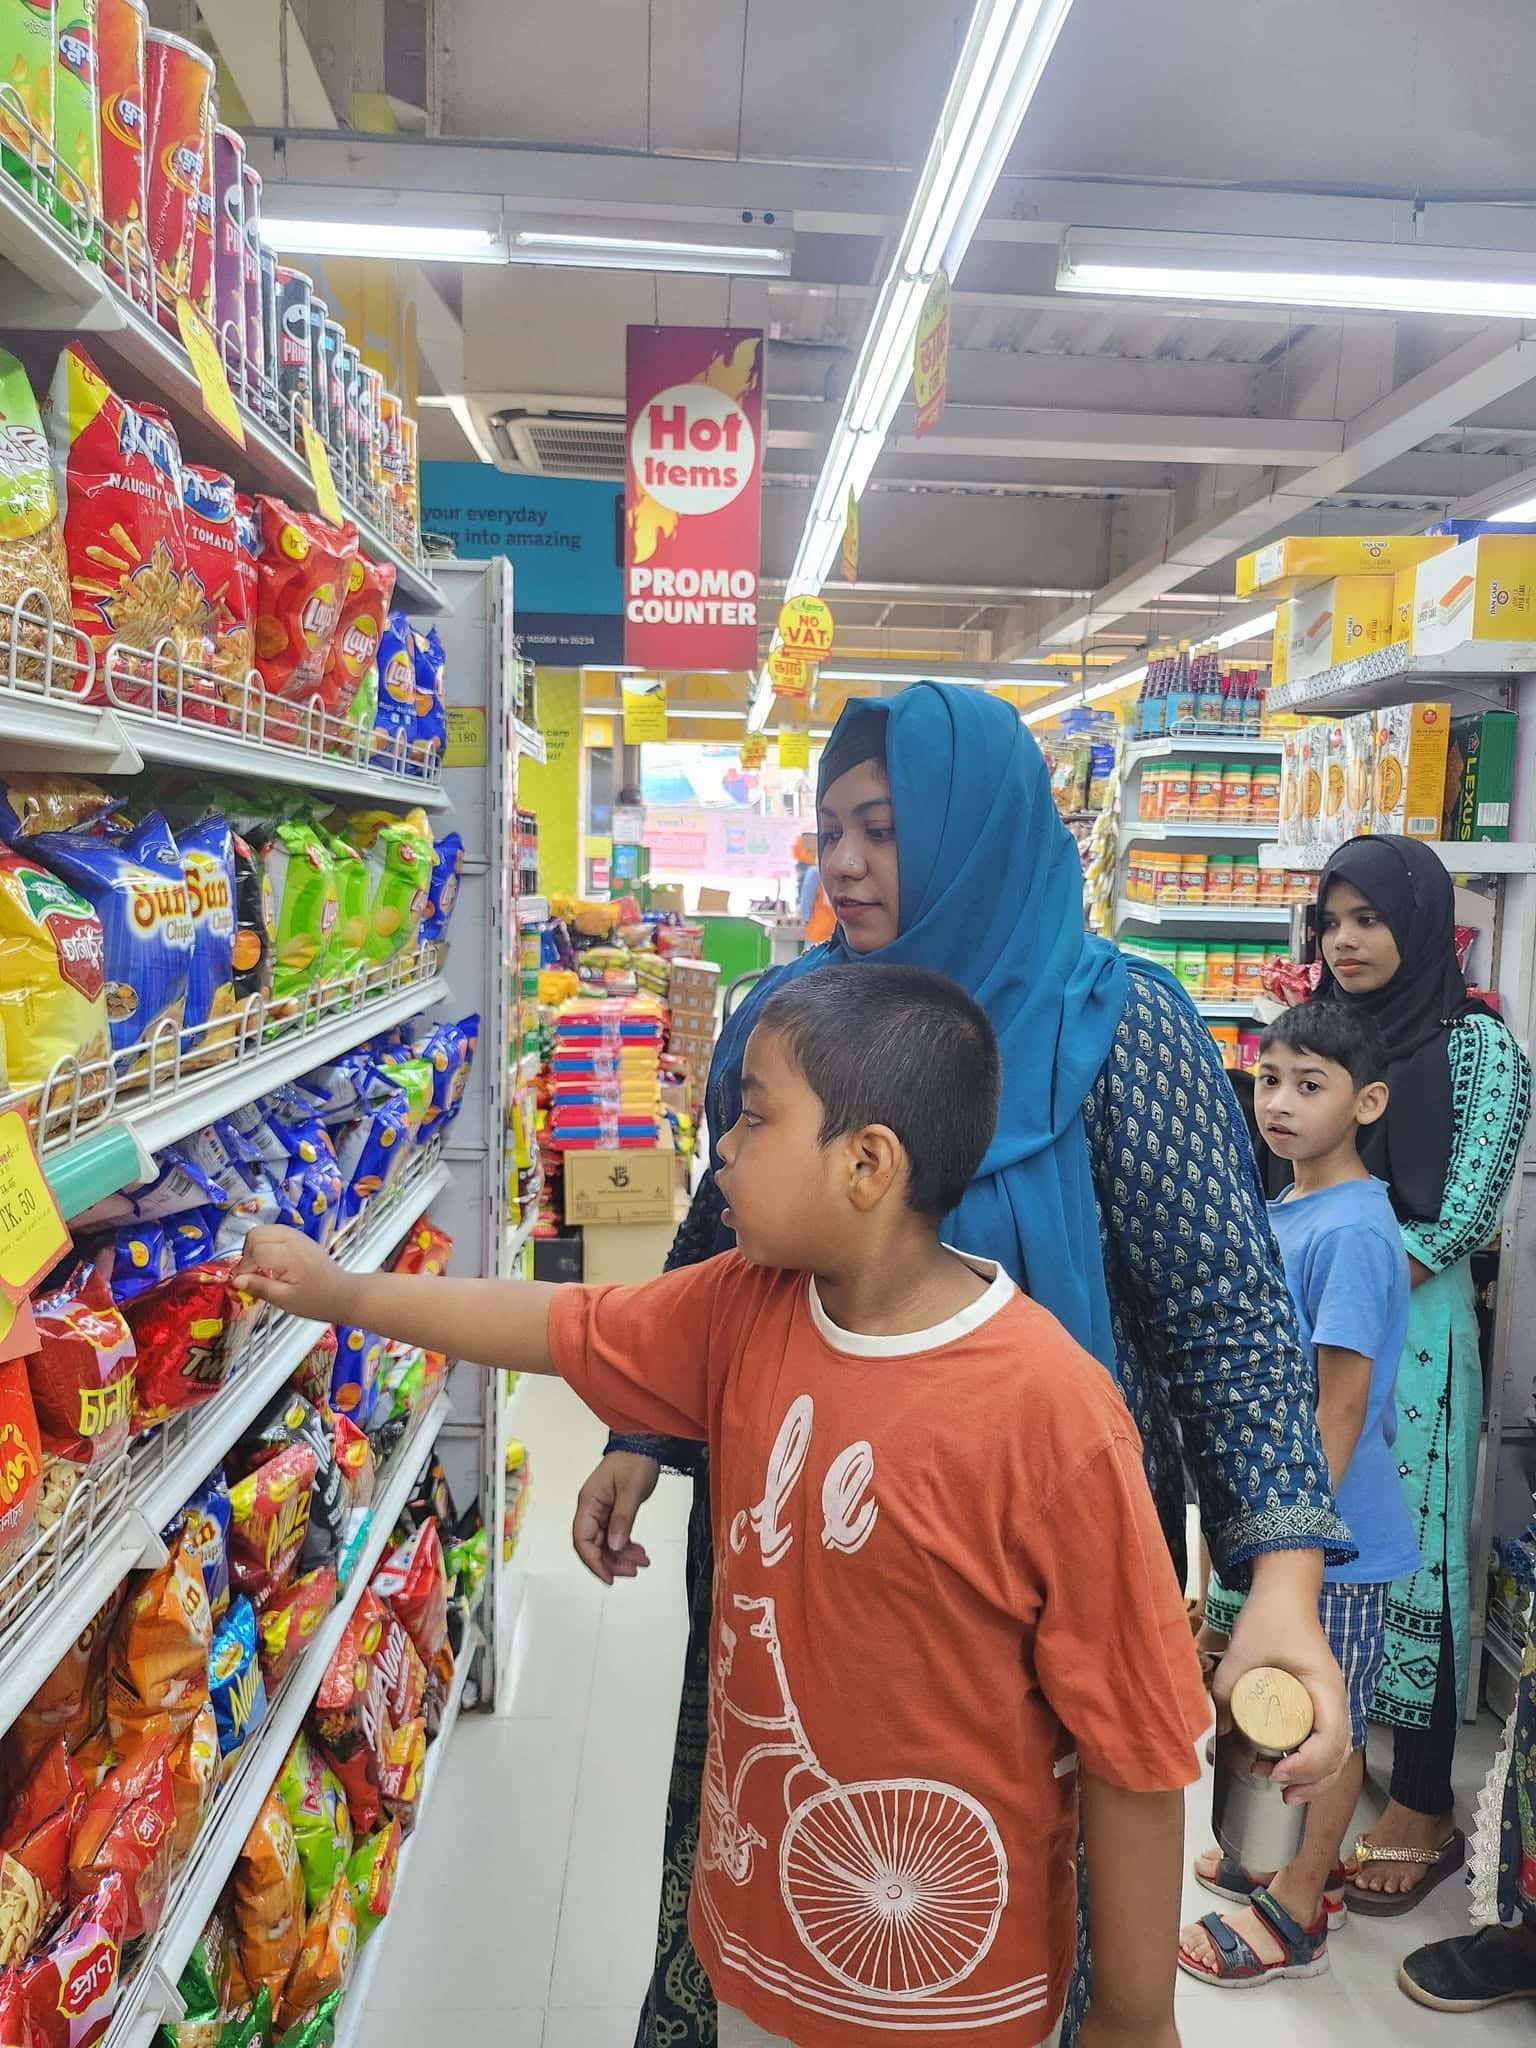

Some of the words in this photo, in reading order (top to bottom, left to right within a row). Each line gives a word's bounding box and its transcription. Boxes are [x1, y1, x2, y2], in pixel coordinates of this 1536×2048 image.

[648, 404, 743, 453] Hot
[110, 472, 162, 502] NAUGHTY
[644, 457, 738, 488] Items
[422, 507, 461, 523] your
[467, 506, 548, 527] everyday
[192, 528, 235, 553] TOMATO
[466, 529, 500, 545] into
[506, 531, 582, 551] amazing
[629, 568, 757, 599] PROMO
[626, 599, 758, 626] COUNTER
[799, 614, 819, 628] NO
[787, 626, 828, 646] VAT
[1460, 756, 1478, 841] LEXUS
[134, 880, 186, 928] Sun
[185, 866, 229, 918] Sun
[19, 1187, 37, 1216] 50
[729, 1393, 880, 1567] cle
[69, 1949, 113, 2005] প্রাণ
